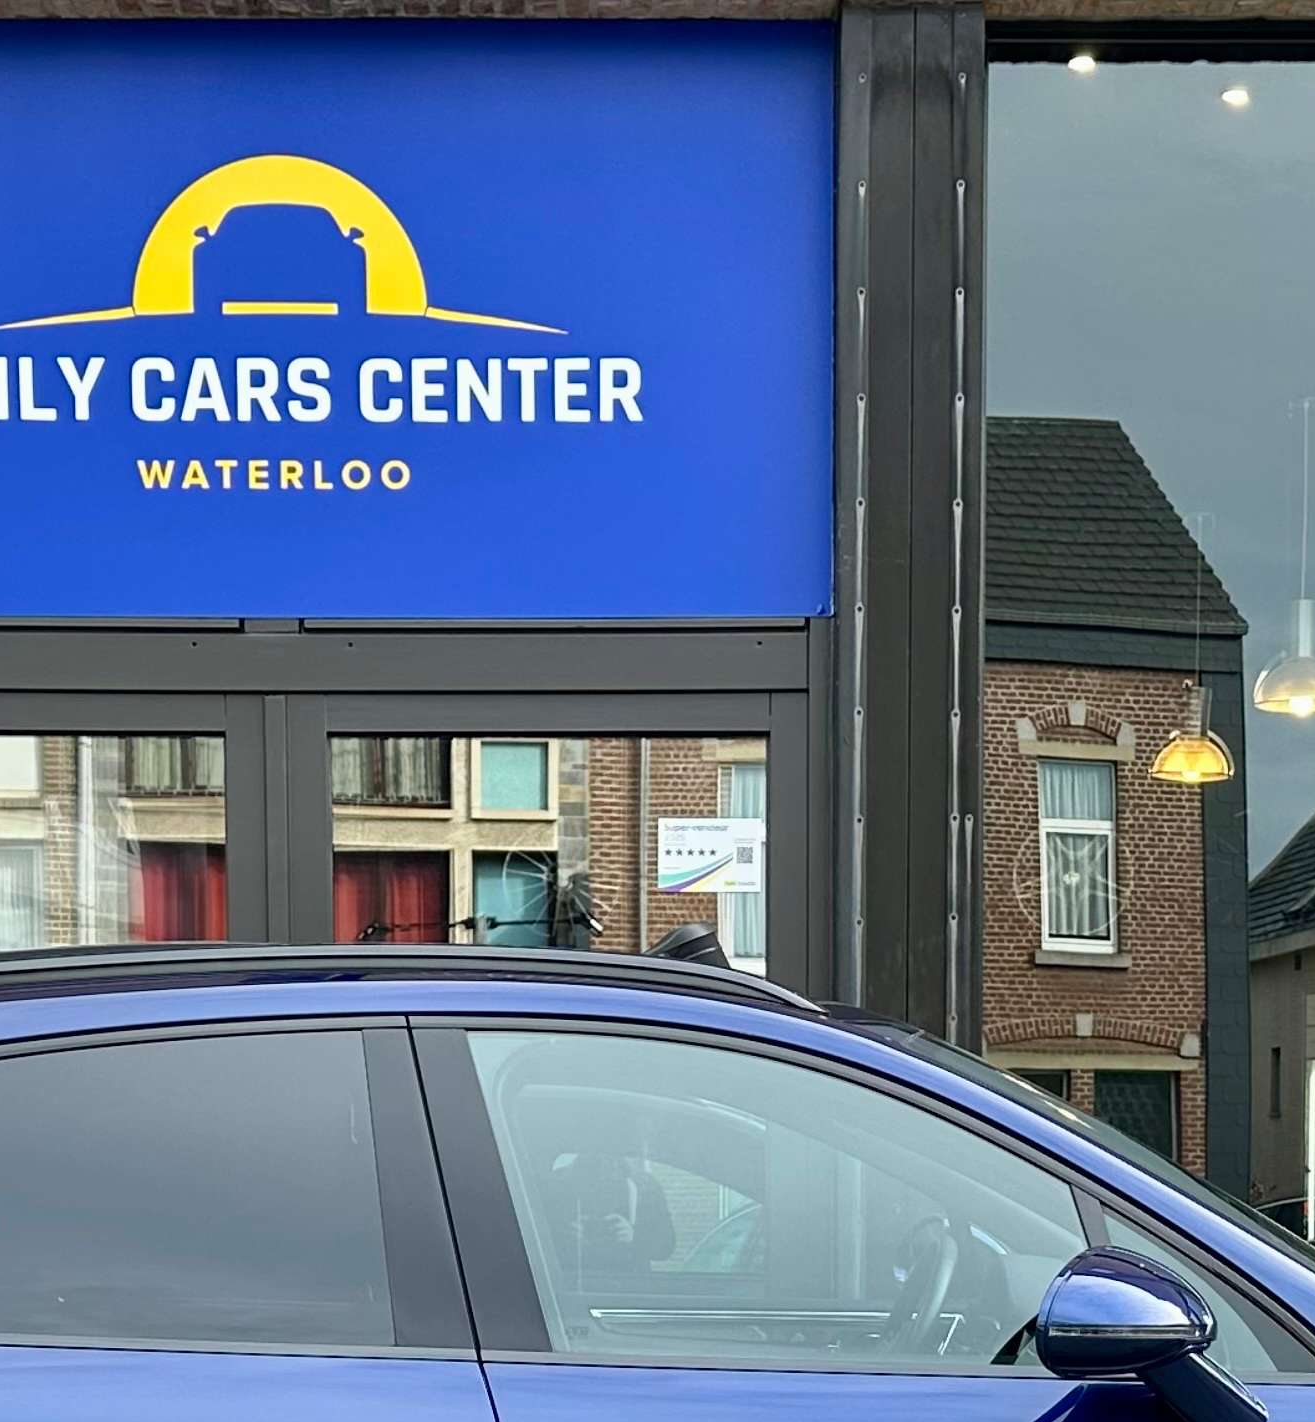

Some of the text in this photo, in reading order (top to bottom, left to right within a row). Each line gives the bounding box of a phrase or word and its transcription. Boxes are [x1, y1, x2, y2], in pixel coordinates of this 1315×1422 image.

[130, 356, 331, 423] CARS
[358, 356, 644, 424] CENTER
[137, 459, 412, 491] WATERLOO
